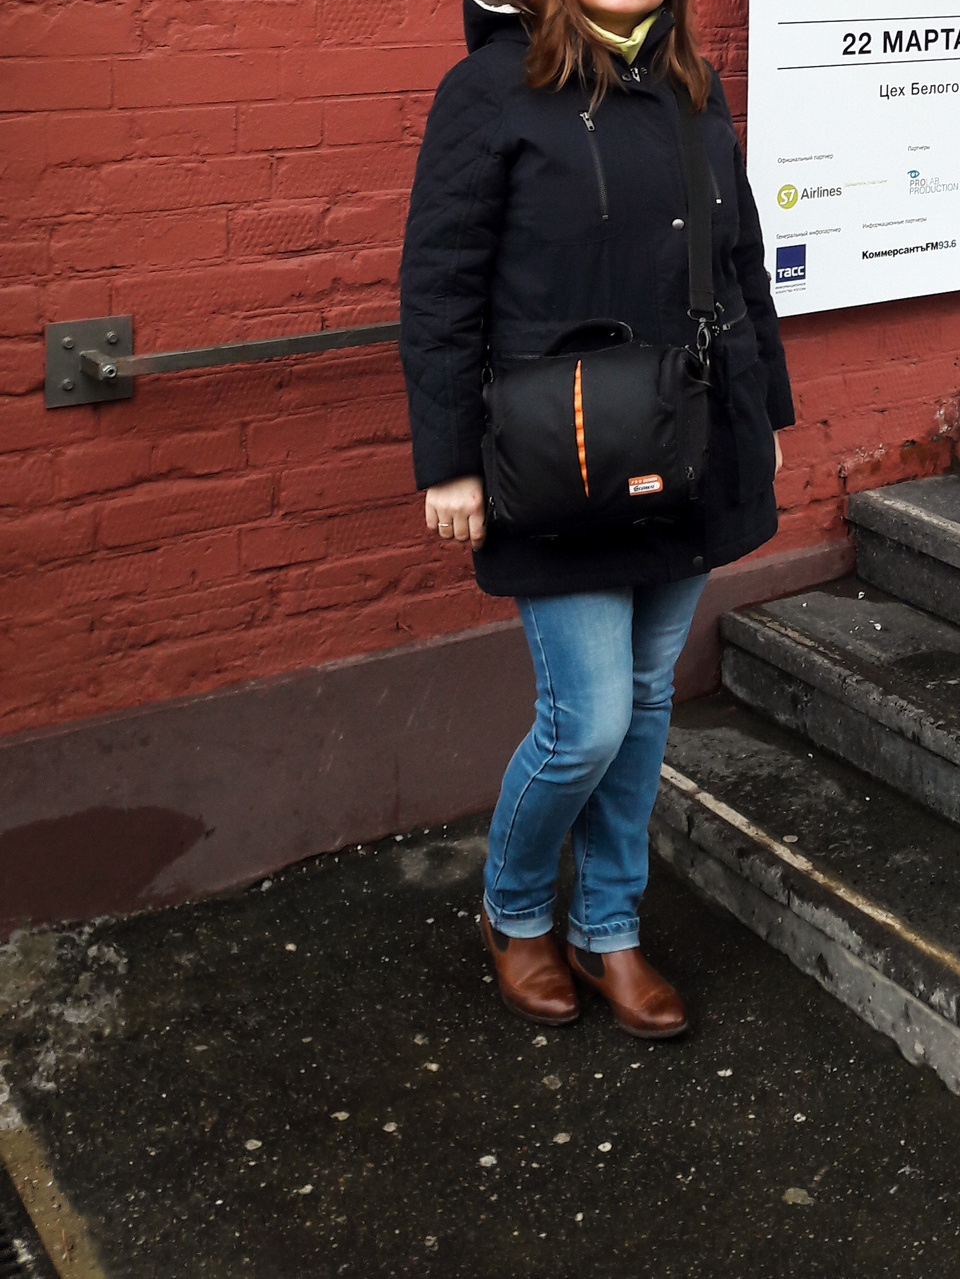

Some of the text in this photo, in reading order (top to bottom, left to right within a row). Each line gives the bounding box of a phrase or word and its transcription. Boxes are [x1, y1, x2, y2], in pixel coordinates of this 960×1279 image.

[842, 32, 872, 56] 22
[879, 83, 905, 99] Цех
[911, 79, 959, 96] Белого
[780, 186, 842, 206] S7 Airlines
[909, 183, 959, 195] PRODUCTION
